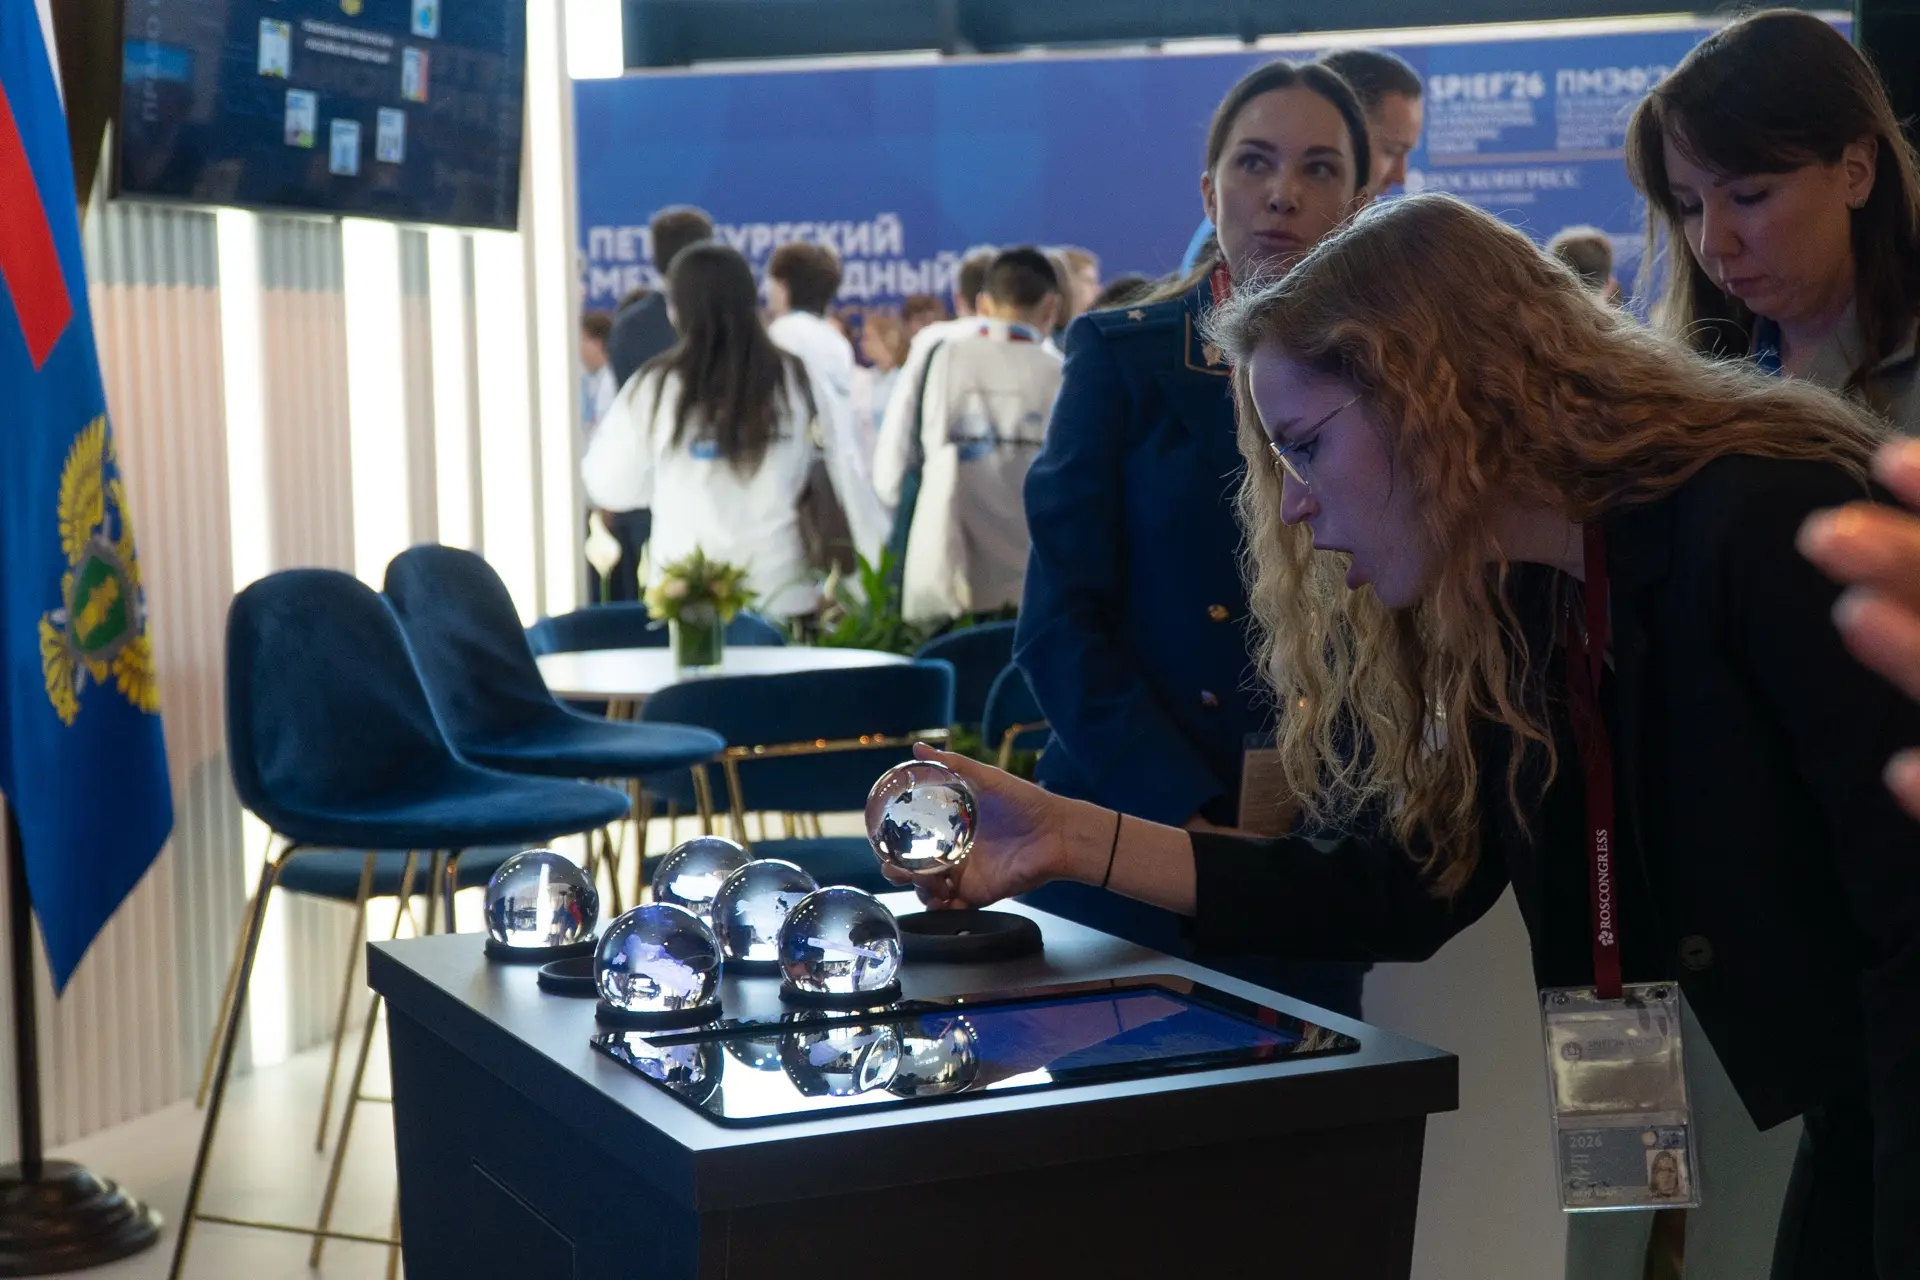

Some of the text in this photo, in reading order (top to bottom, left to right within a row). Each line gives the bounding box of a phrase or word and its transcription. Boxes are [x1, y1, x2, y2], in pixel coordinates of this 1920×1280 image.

[1428, 71, 1545, 101] SPIEF'26
[1556, 66, 1673, 95] ПМЭФ'2
[1596, 829, 1612, 929] ROSCONGRESS
[1569, 1135, 1603, 1149] 2026
